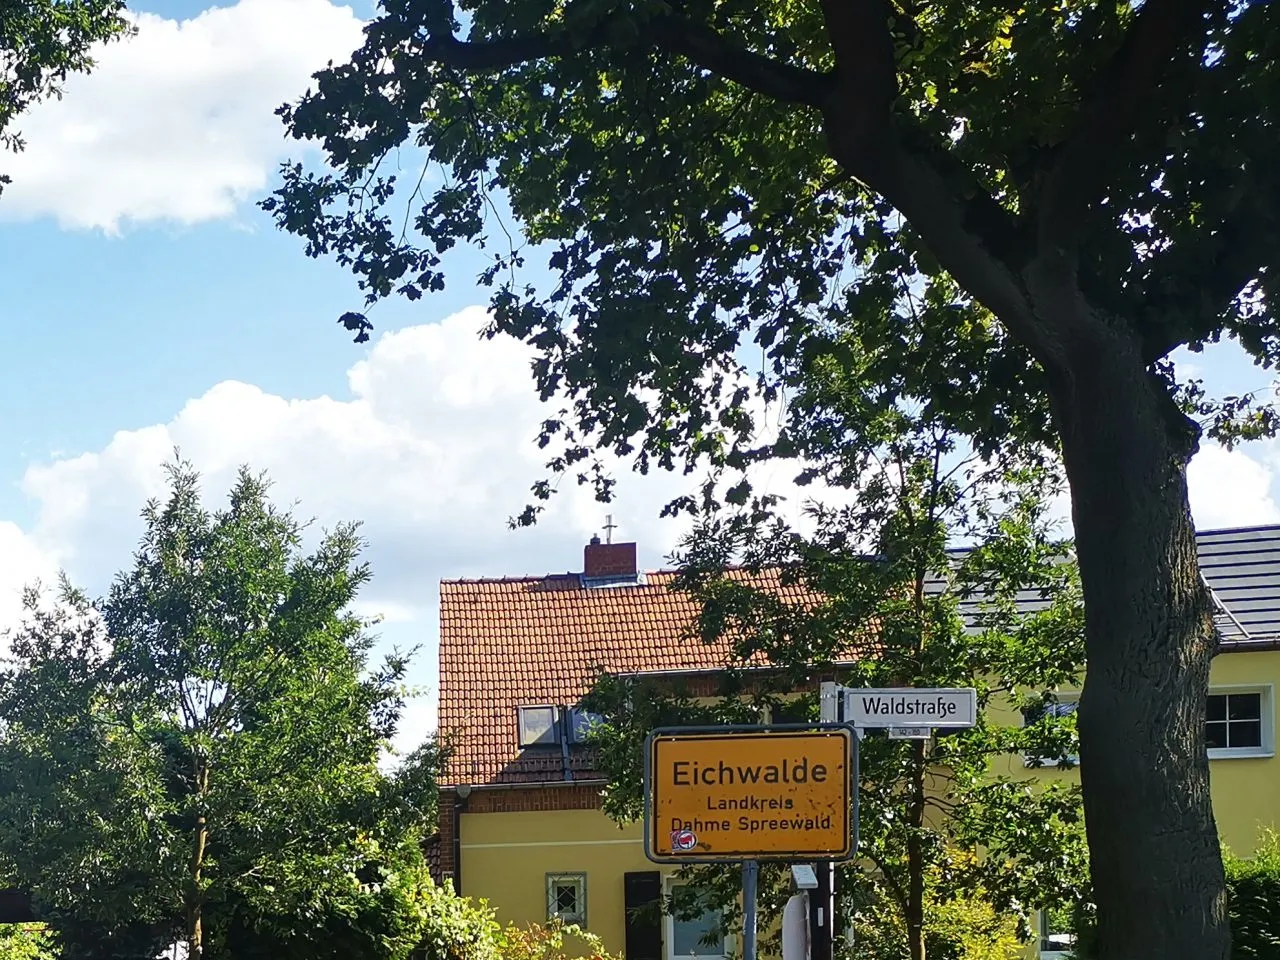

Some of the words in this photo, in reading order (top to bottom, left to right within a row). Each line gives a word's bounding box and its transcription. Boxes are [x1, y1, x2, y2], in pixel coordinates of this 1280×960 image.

[862, 696, 957, 719] Waldstraße
[672, 756, 828, 786] Eichwalde
[707, 796, 794, 811] Landkreis
[671, 817, 731, 832] Dahme
[738, 815, 832, 833] Spreewald
